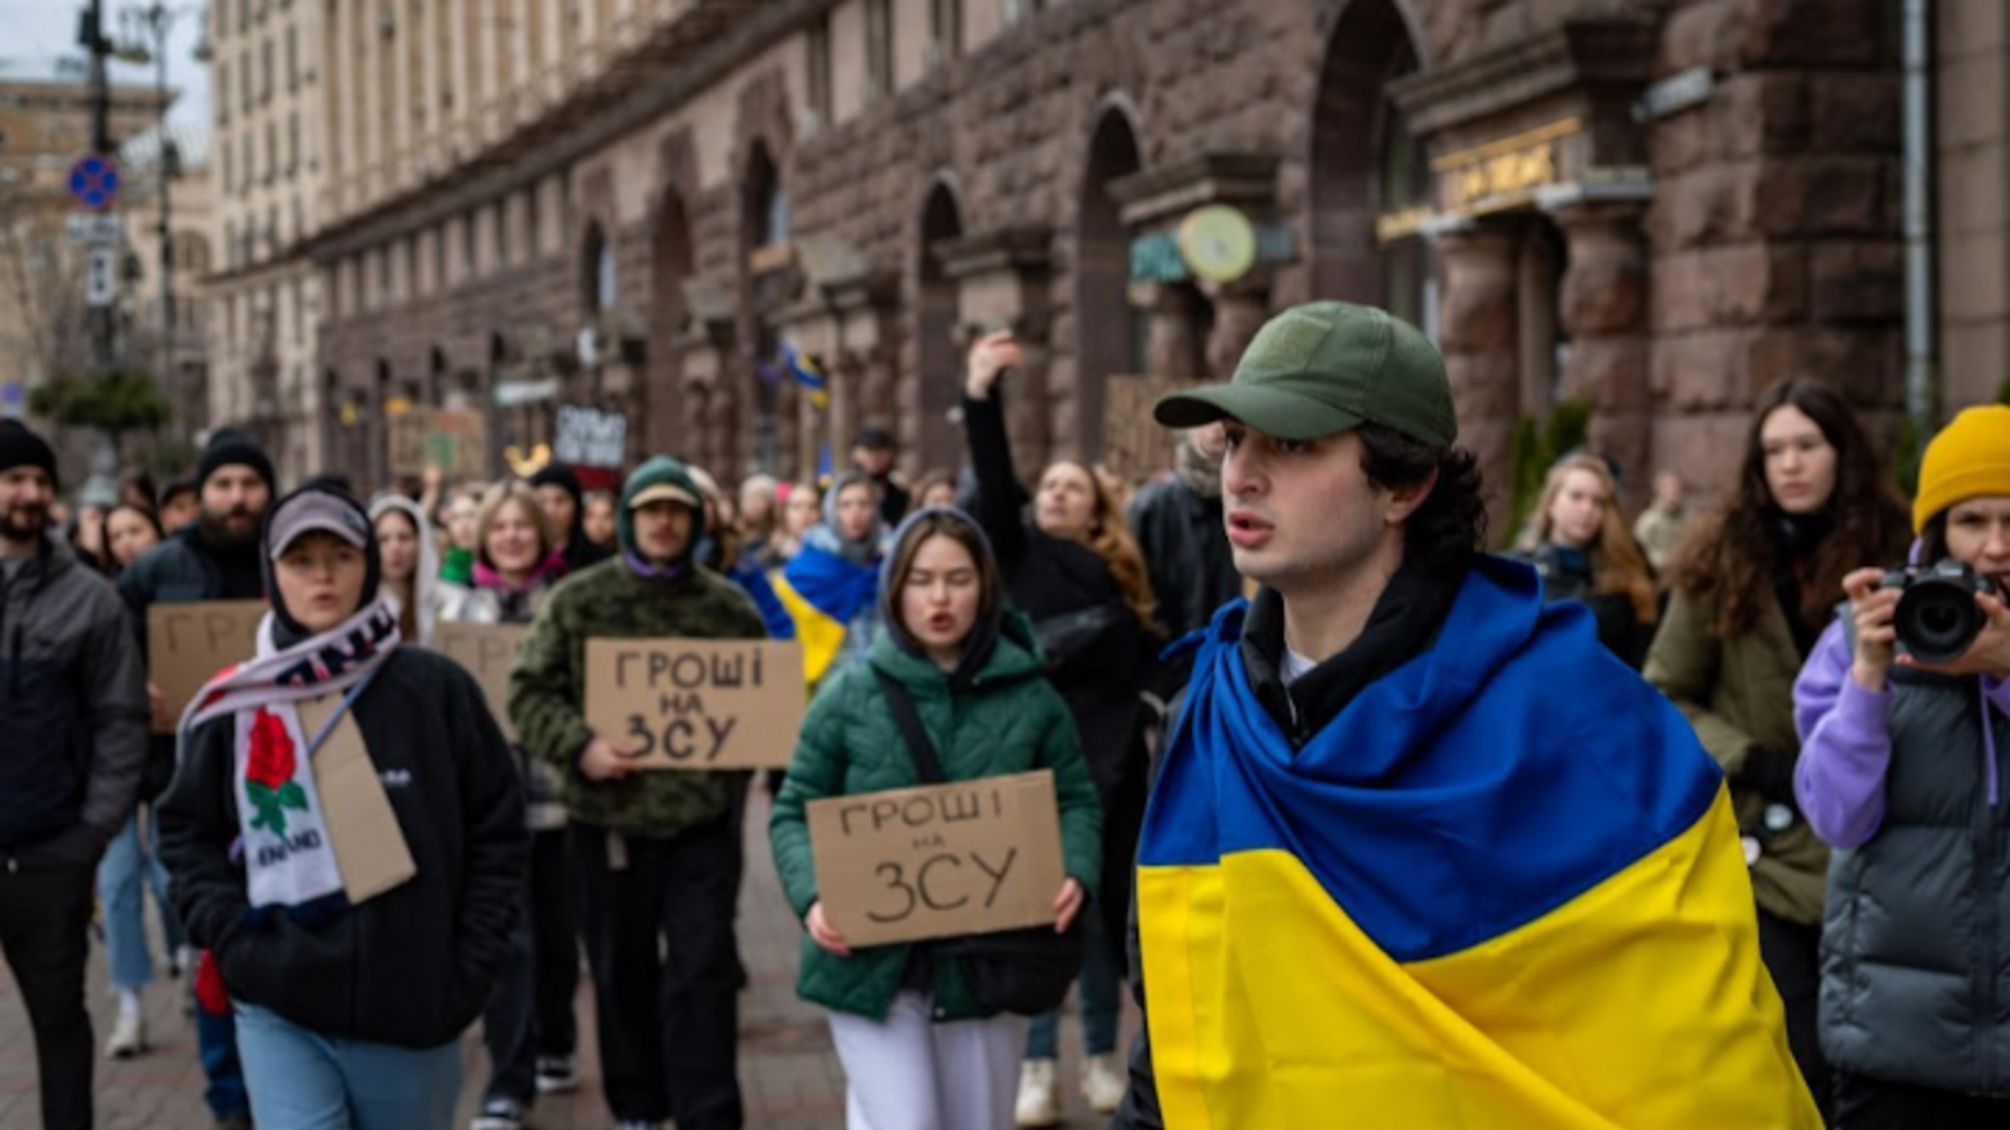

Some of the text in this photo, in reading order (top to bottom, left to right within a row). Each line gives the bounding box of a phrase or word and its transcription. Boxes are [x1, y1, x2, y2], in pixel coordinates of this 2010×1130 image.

[660, 690, 704, 716] НА
[622, 712, 738, 762] ЗСУ
[839, 787, 1002, 837] ГРОШІ
[866, 846, 1019, 924] ЗСУ
